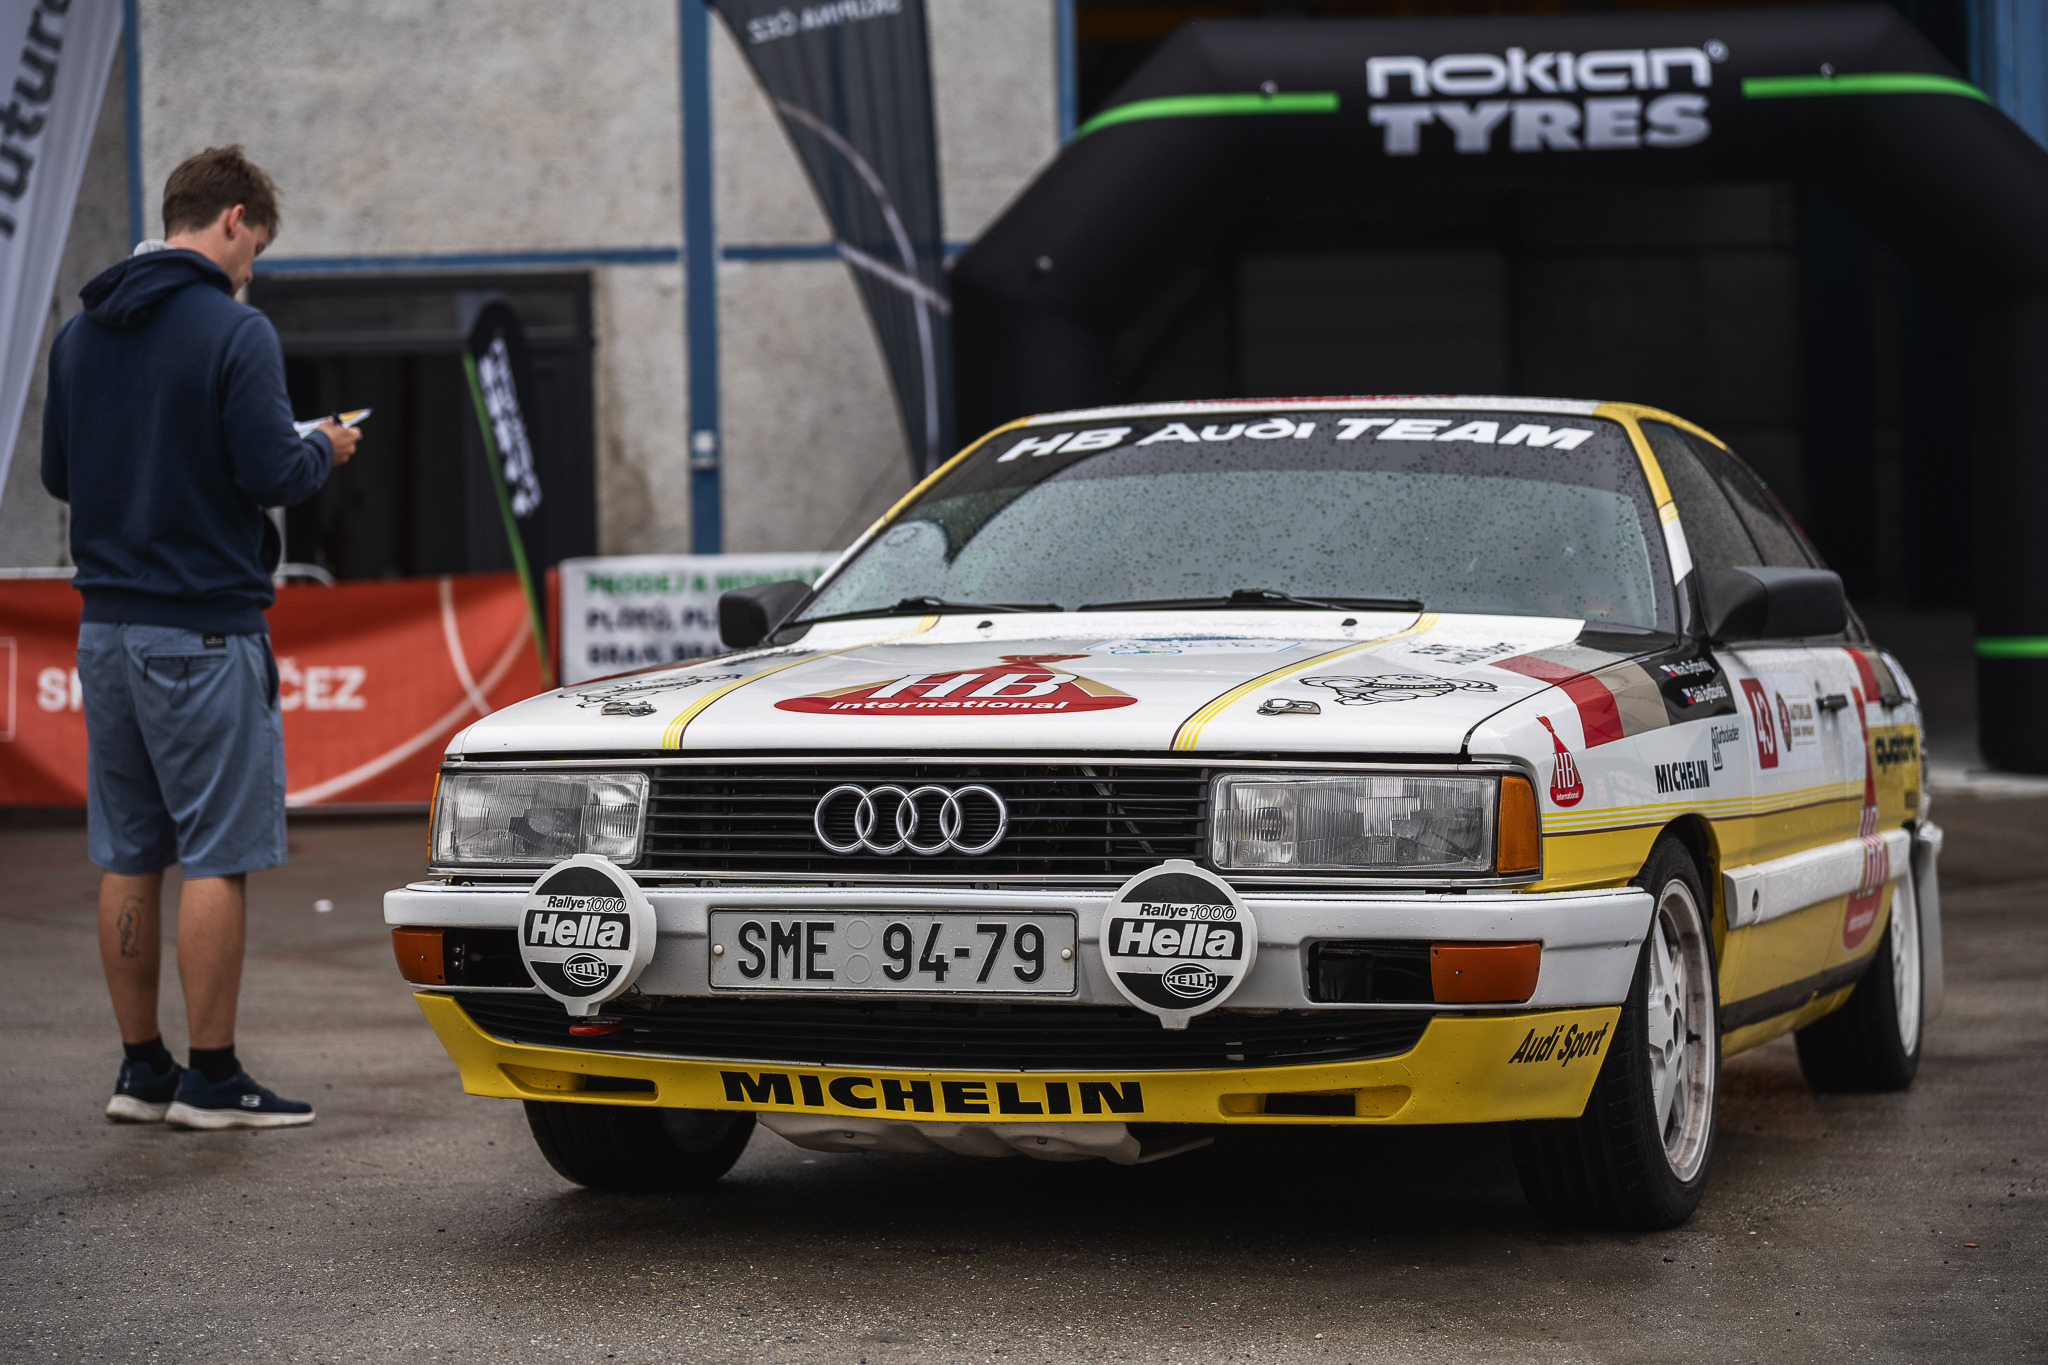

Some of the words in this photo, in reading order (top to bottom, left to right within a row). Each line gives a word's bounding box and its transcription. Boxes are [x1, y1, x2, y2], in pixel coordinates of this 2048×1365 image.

[1369, 92, 1711, 155] TYRES
[997, 427, 1132, 463] HB
[1135, 418, 1316, 446] Audi
[1335, 418, 1595, 450] TEAM
[865, 673, 1079, 699] HB
[828, 699, 1070, 710] international
[1751, 691, 1774, 755] 43
[1552, 751, 1575, 789] HB
[1655, 760, 1710, 794] MICHELIN
[547, 896, 585, 911] Rallye
[586, 896, 627, 912] 1000
[1139, 903, 1188, 919] Rallye
[1189, 905, 1237, 921] 1000
[530, 913, 624, 948] Hella
[1117, 921, 1235, 958] Hella
[566, 961, 608, 977] HELLA
[737, 920, 835, 981] SME
[882, 921, 1046, 983] 94-79
[1166, 972, 1217, 988] HELLA
[1507, 1024, 1565, 1064] Audi
[1557, 1021, 1609, 1067] Sport
[720, 1070, 1145, 1115] MICHELIN
